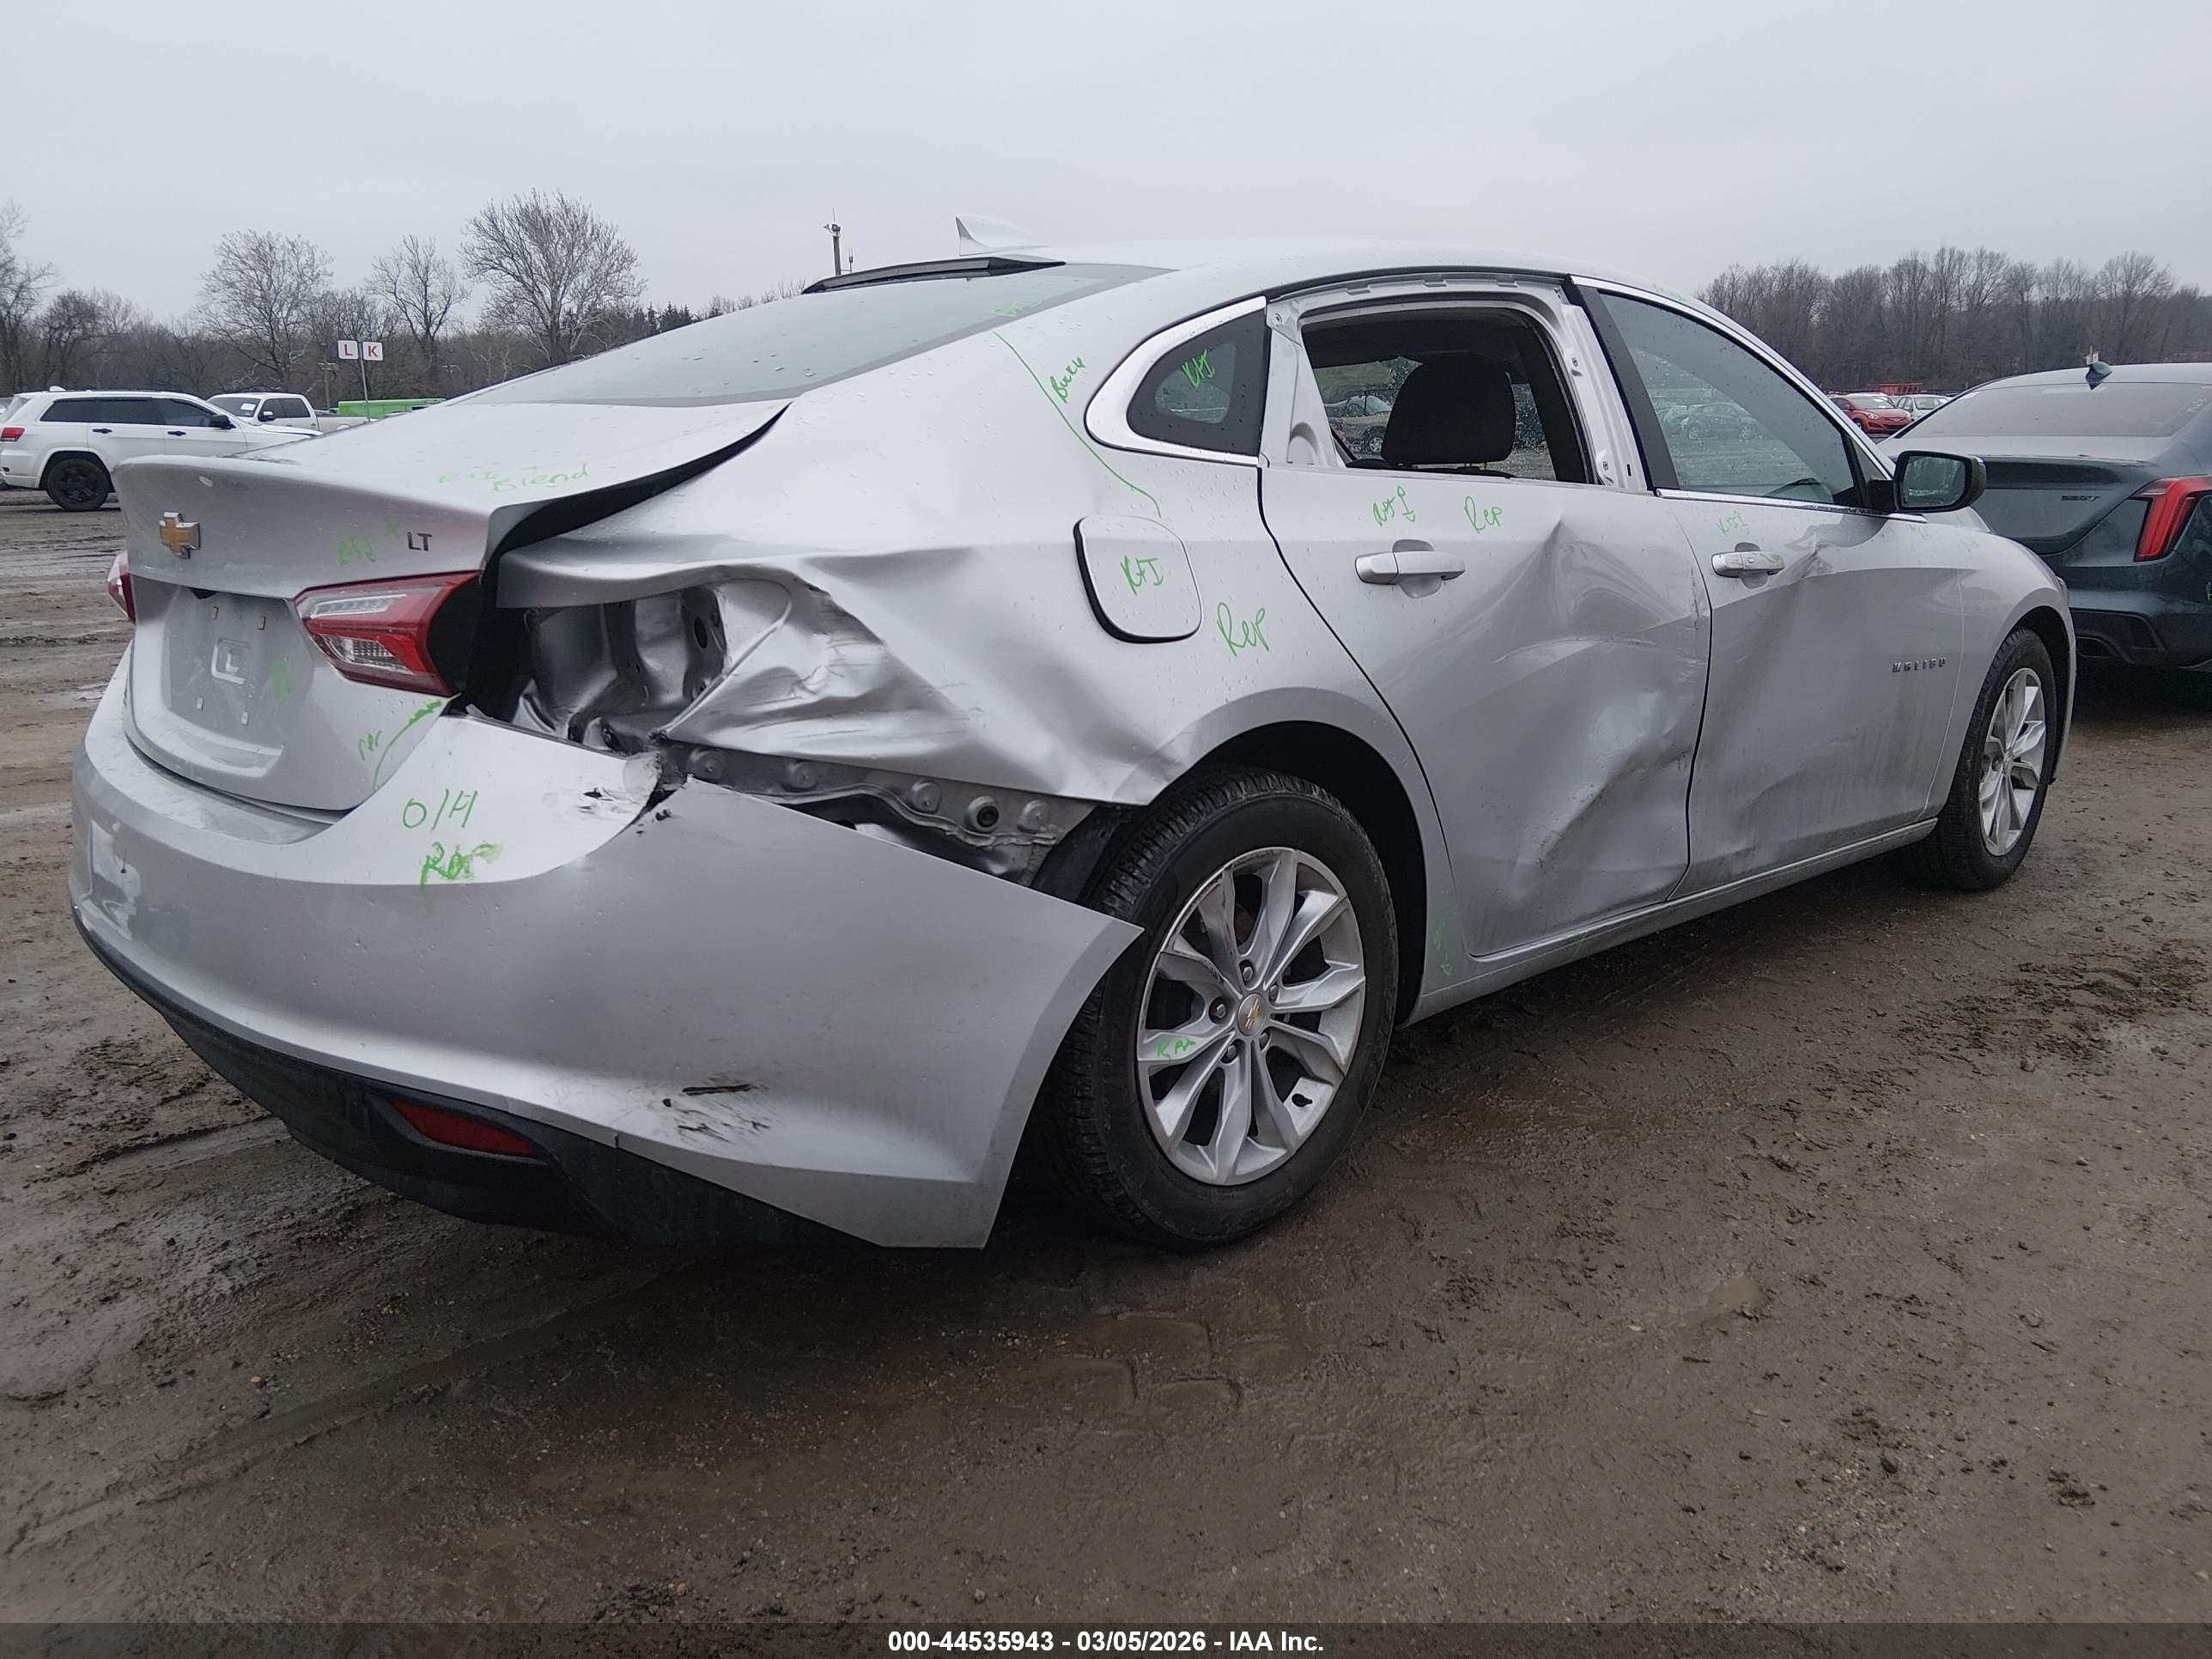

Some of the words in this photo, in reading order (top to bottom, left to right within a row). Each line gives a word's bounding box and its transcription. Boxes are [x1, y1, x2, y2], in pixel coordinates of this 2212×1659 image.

[344, 343, 354, 356] L
[368, 345, 379, 358] K
[407, 532, 433, 551] LT
